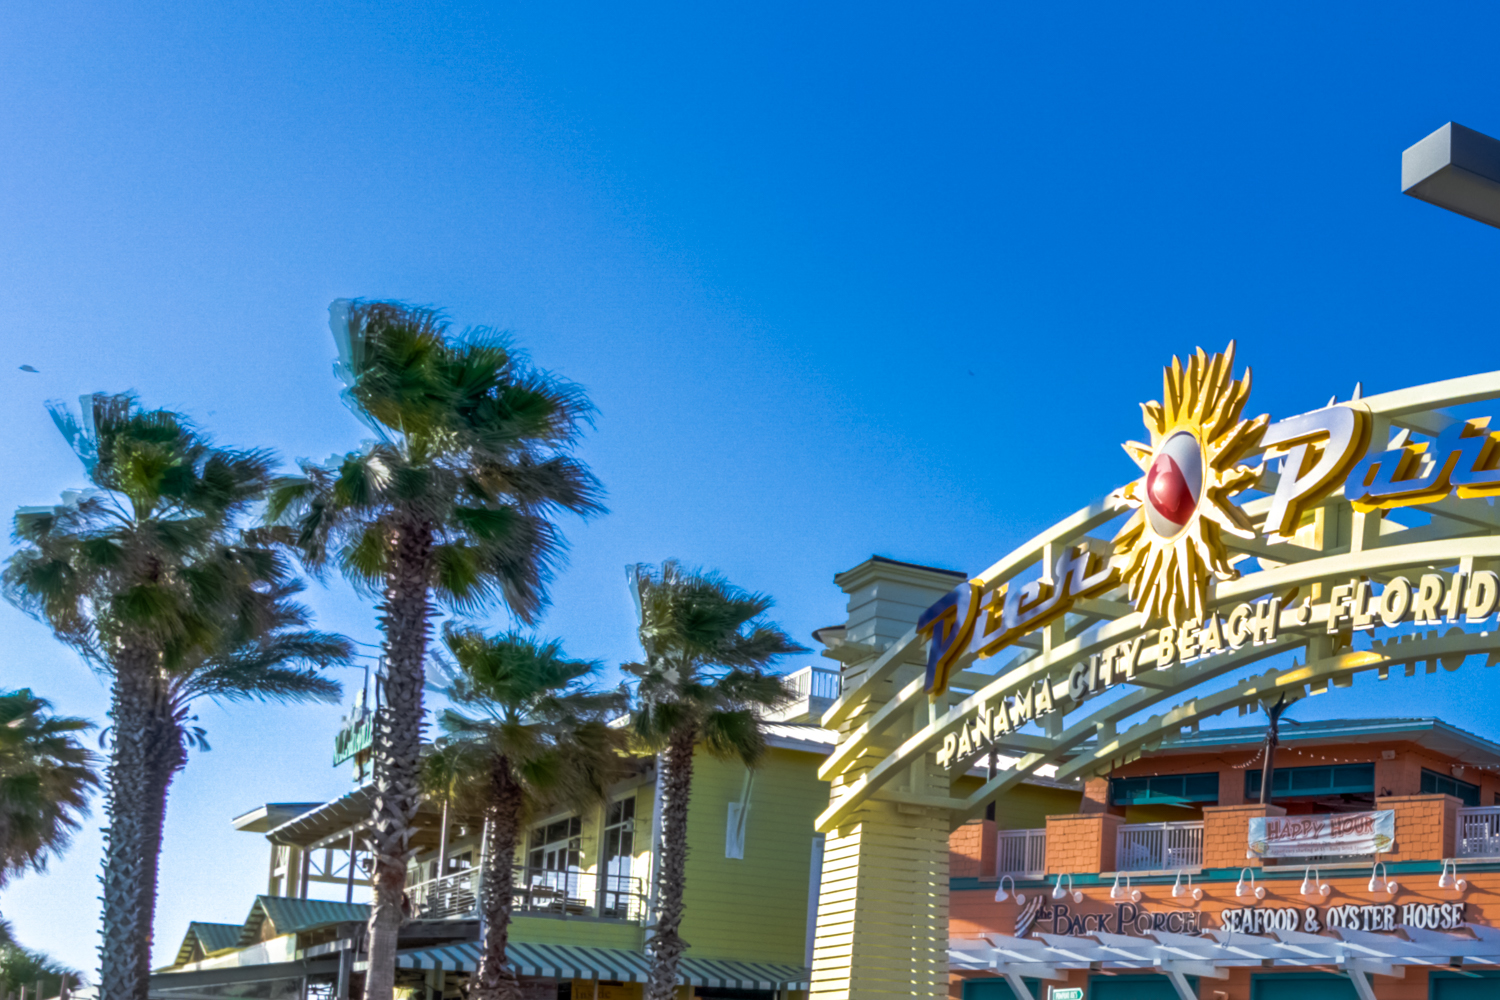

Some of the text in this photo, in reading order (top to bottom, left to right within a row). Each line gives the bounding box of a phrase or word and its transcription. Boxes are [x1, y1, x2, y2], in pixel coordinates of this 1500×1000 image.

[916, 546, 1122, 698] Pier
[941, 674, 1057, 769] PANAMA
[1068, 635, 1146, 701] CITY
[1157, 597, 1281, 671] BEACH
[1266, 816, 1376, 841] HAPPY HOUR
[1035, 902, 1465, 937] the BACK PORCH SEAFOOD & OYSTER HOUSE
[575, 987, 611, 999] Insde
